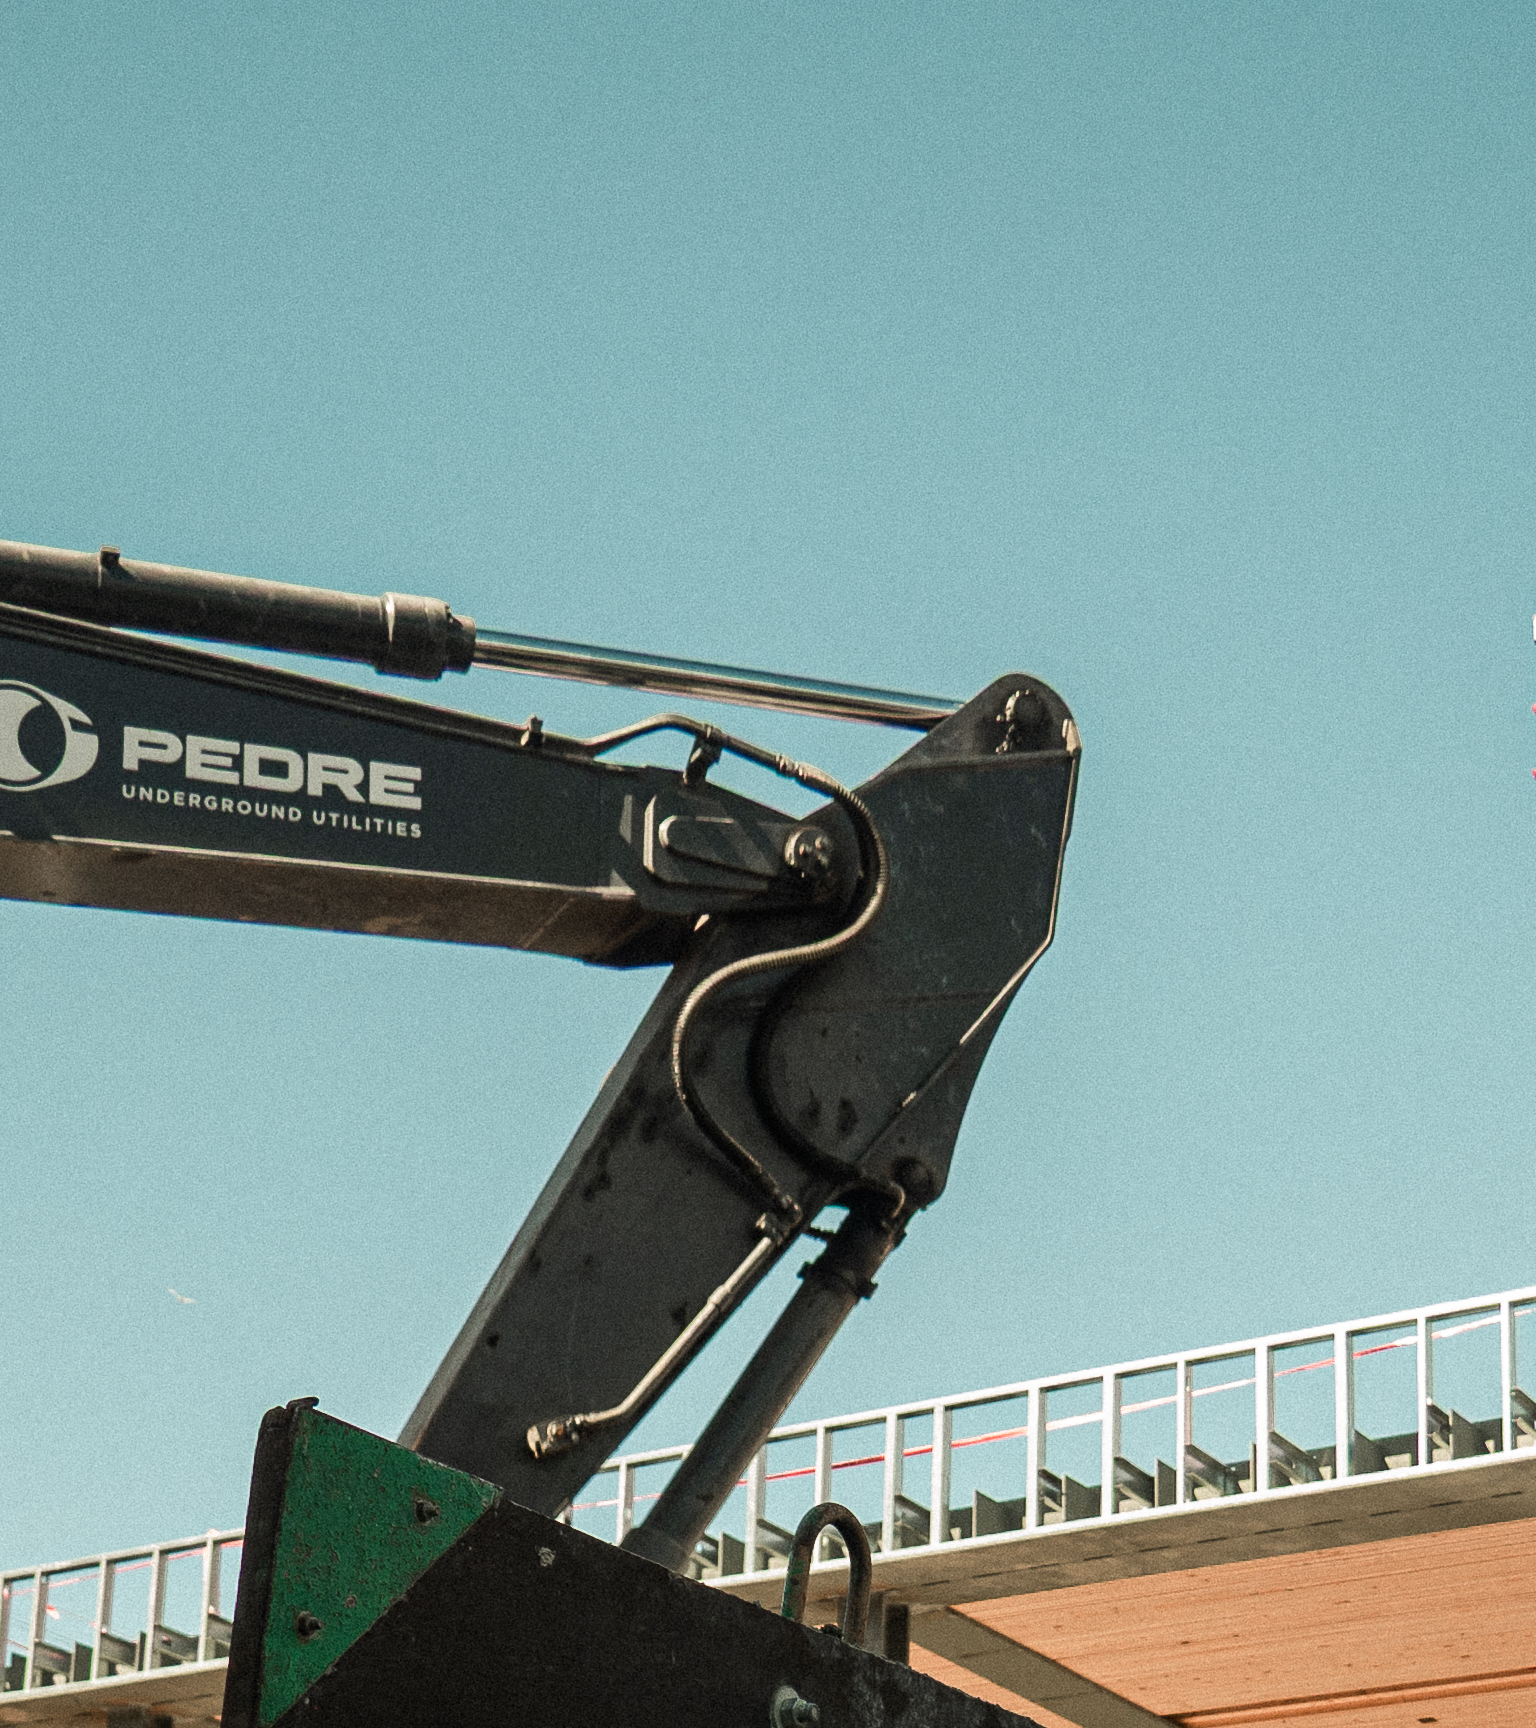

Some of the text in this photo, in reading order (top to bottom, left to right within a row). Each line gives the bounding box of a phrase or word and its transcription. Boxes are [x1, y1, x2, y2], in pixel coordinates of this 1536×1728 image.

[122, 725, 423, 811] PEDRE
[121, 784, 422, 838] UNDERGROUND UTILITIES
